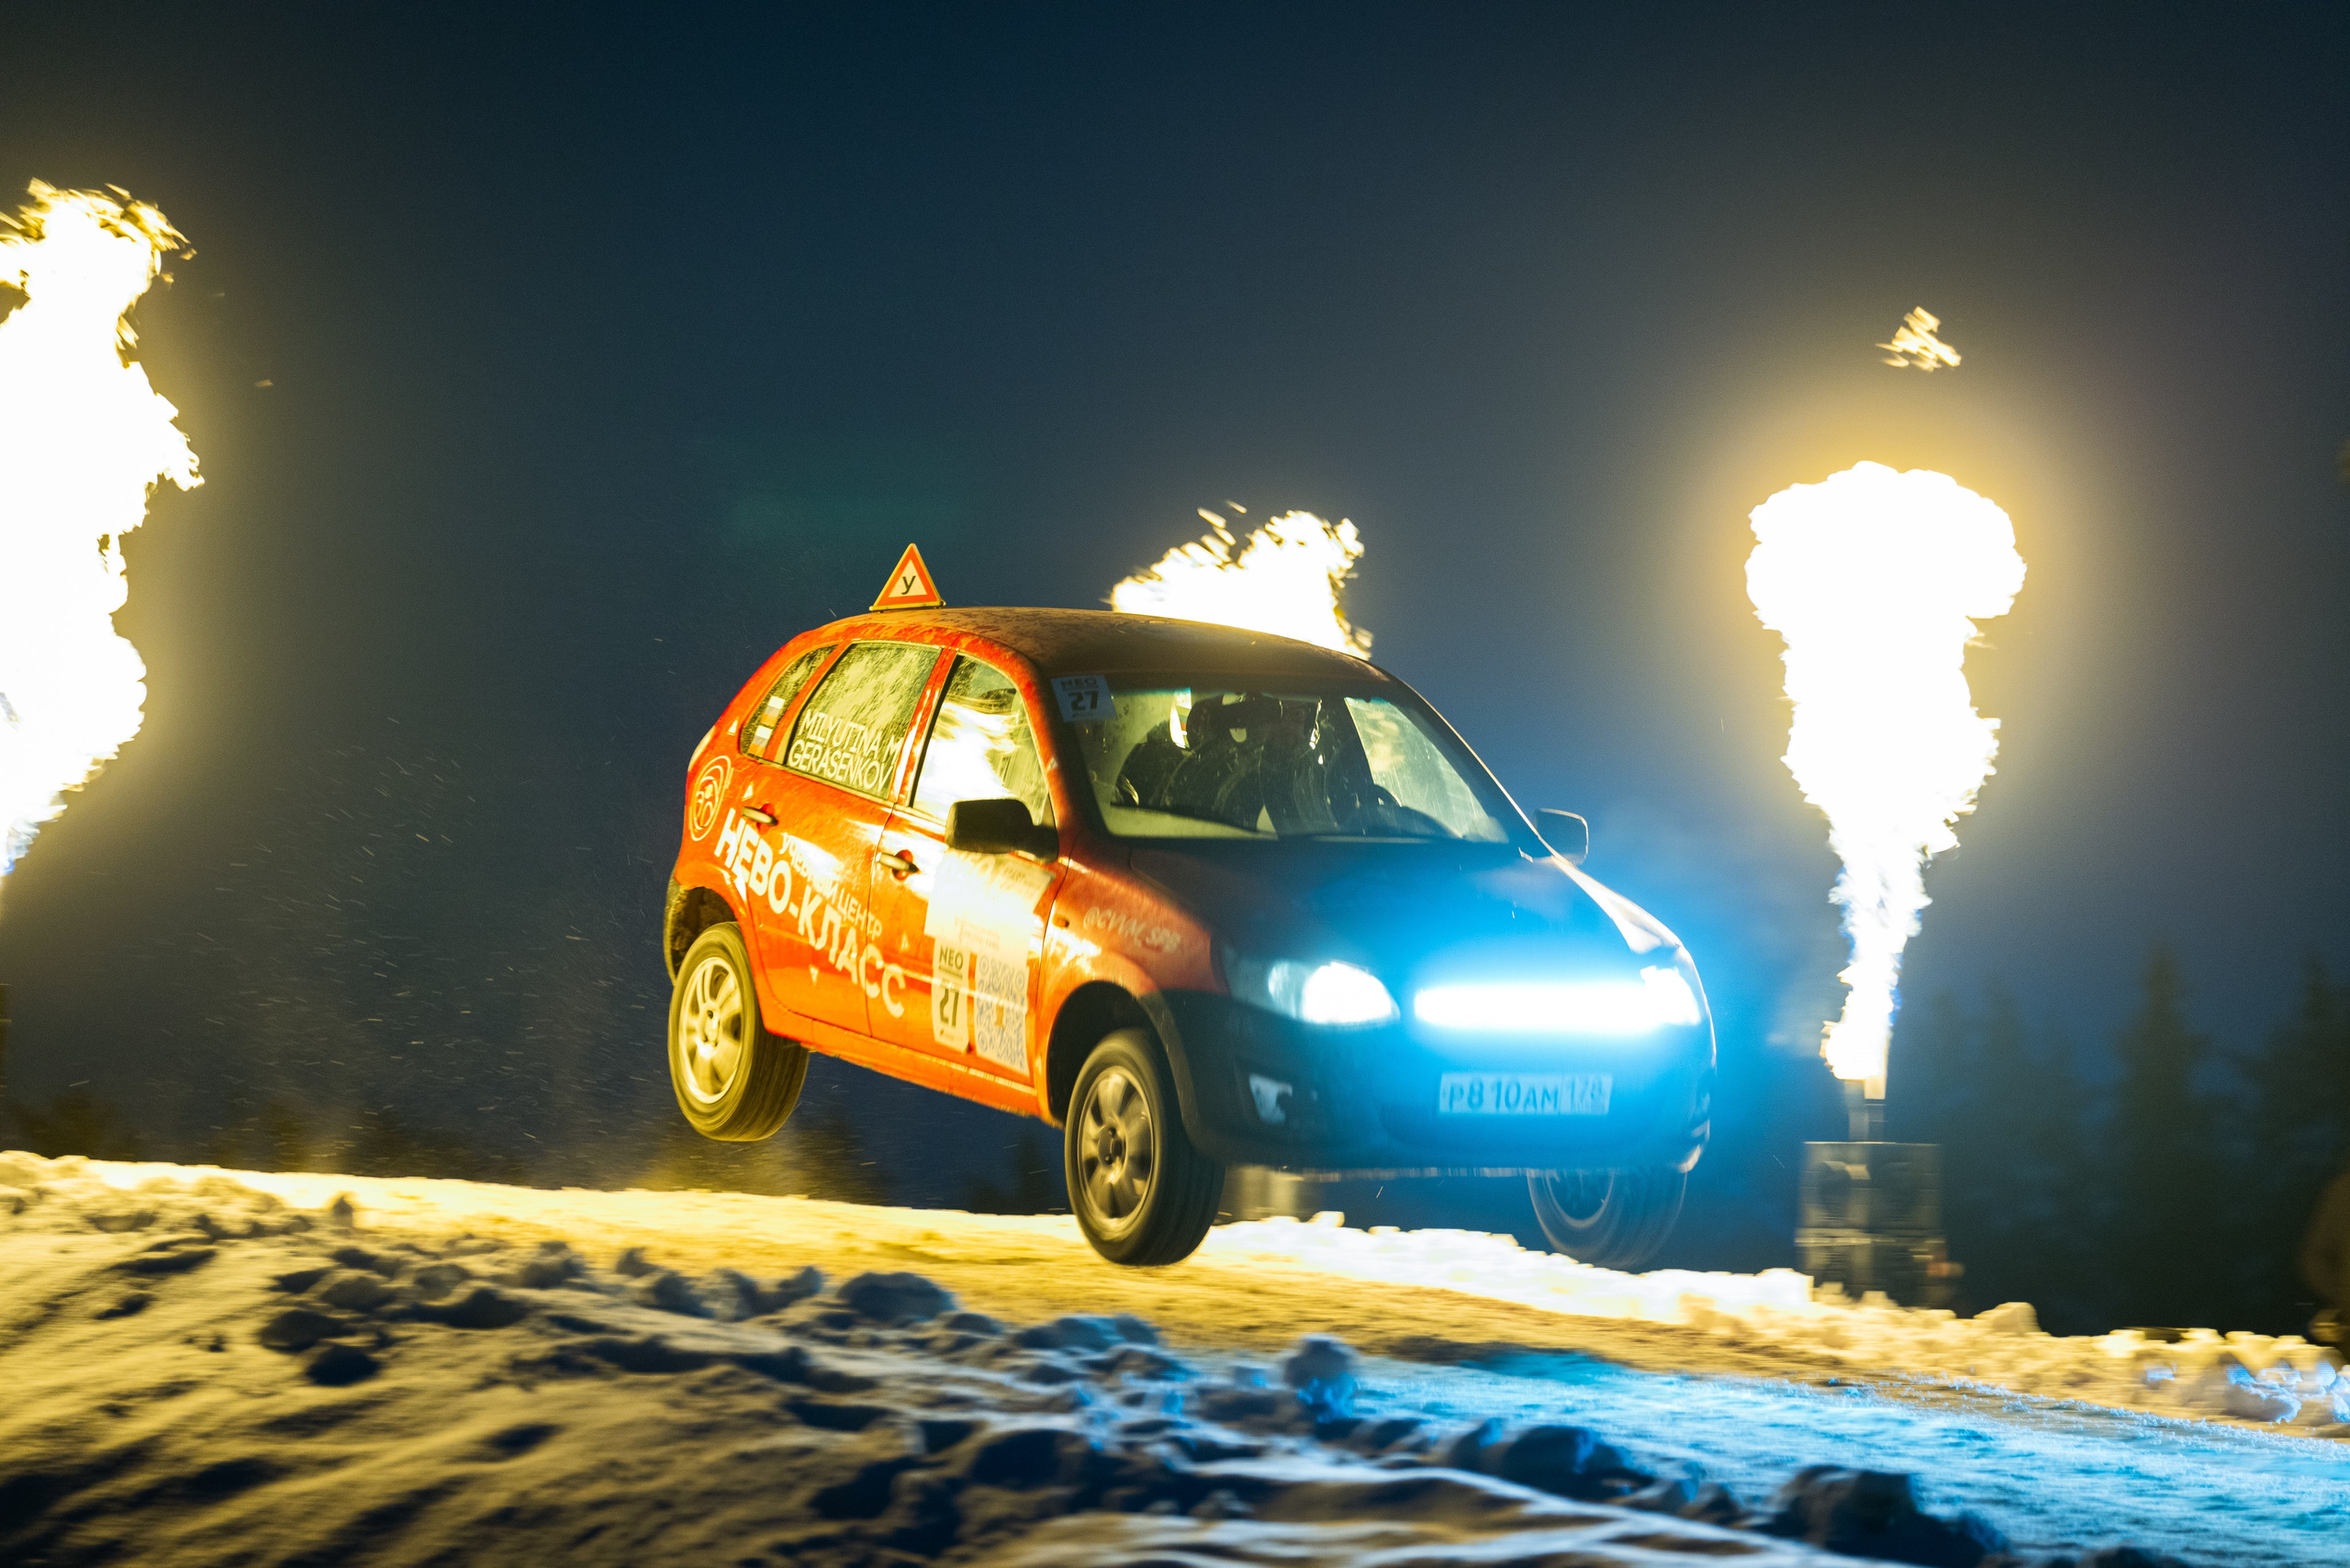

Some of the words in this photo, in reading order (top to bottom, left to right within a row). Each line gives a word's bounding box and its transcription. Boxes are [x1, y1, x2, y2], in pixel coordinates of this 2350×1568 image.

[1068, 690, 1098, 711] 27
[798, 709, 882, 760] MILYUTINA
[789, 739, 894, 793] GERASENKOV
[714, 808, 906, 1018] НЕВО-КЛАСС
[837, 887, 883, 940] ЦЕНТР
[939, 944, 964, 971] NEO
